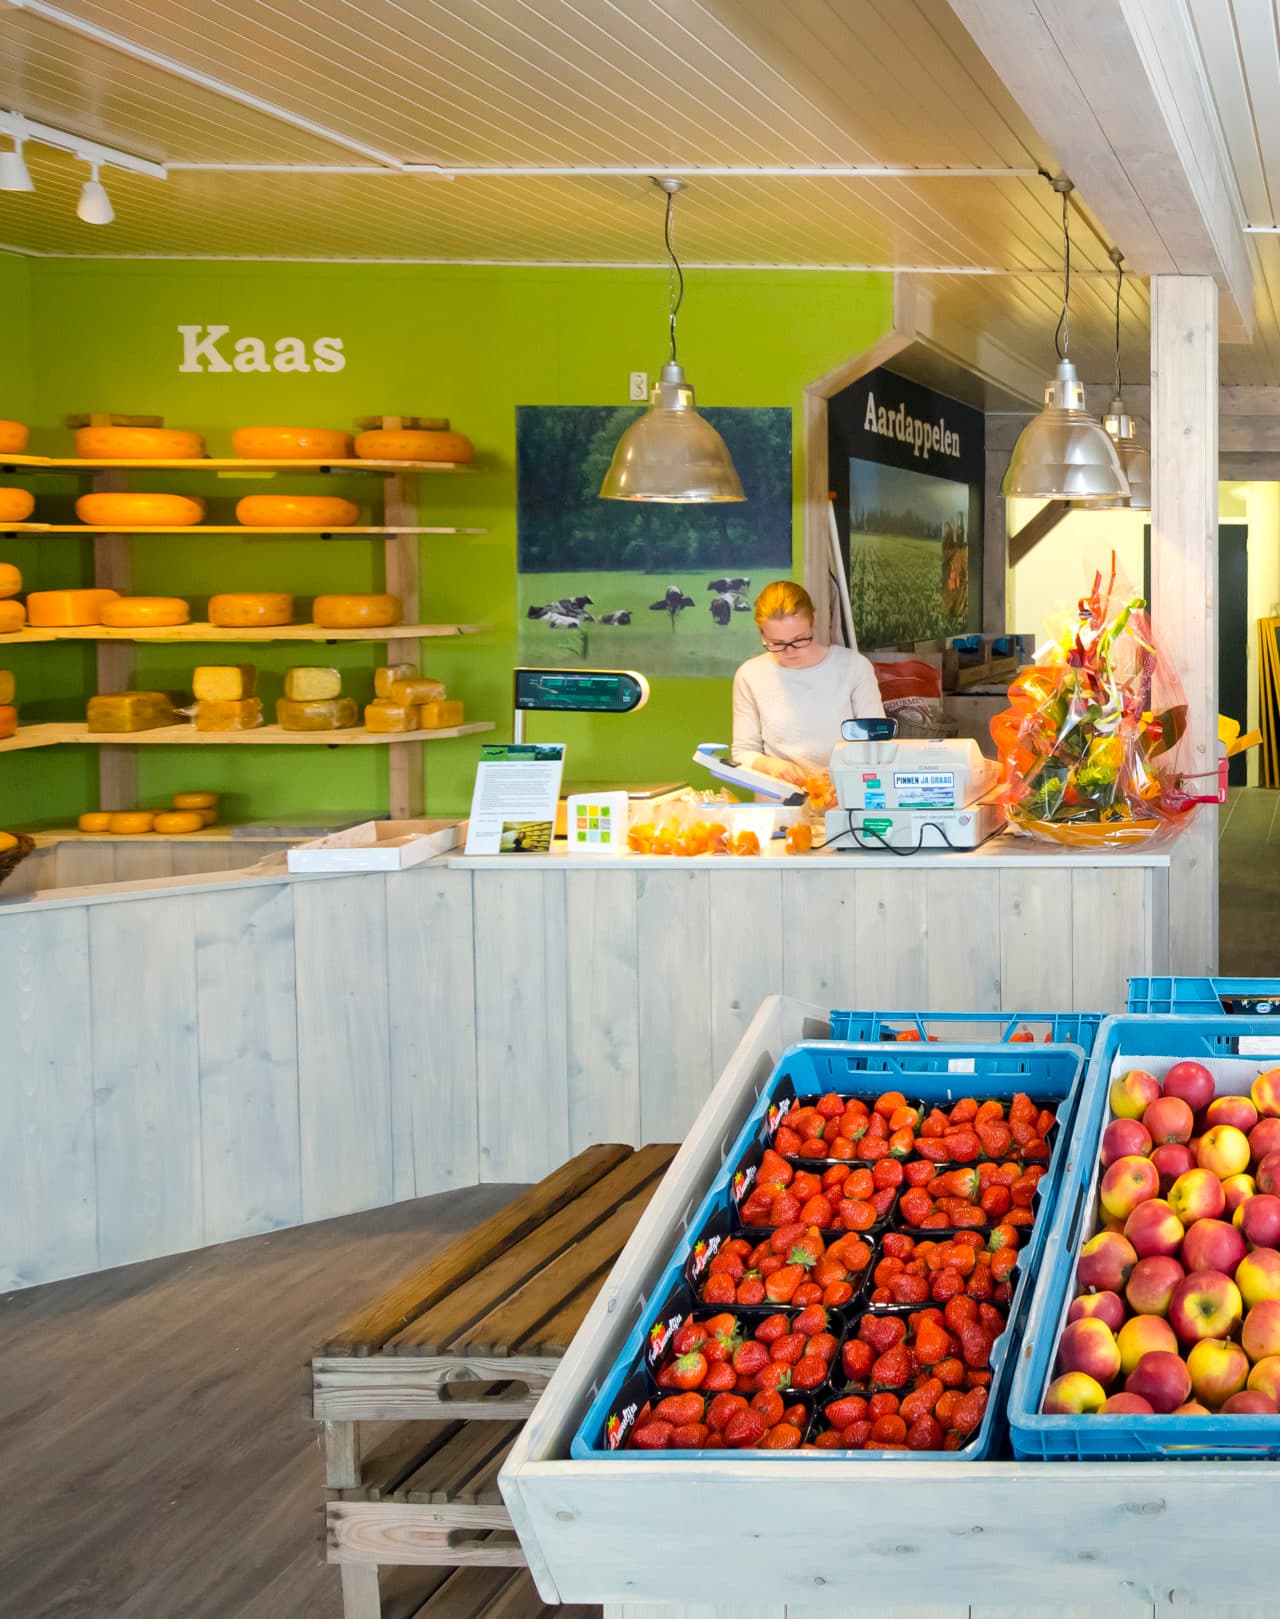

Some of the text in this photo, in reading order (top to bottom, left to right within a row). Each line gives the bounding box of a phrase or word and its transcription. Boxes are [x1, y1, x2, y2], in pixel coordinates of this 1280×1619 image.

[177, 325, 346, 373] Kaas
[864, 391, 961, 459] Aardappelen
[896, 776, 952, 784] PINNEN JA GRAAG
